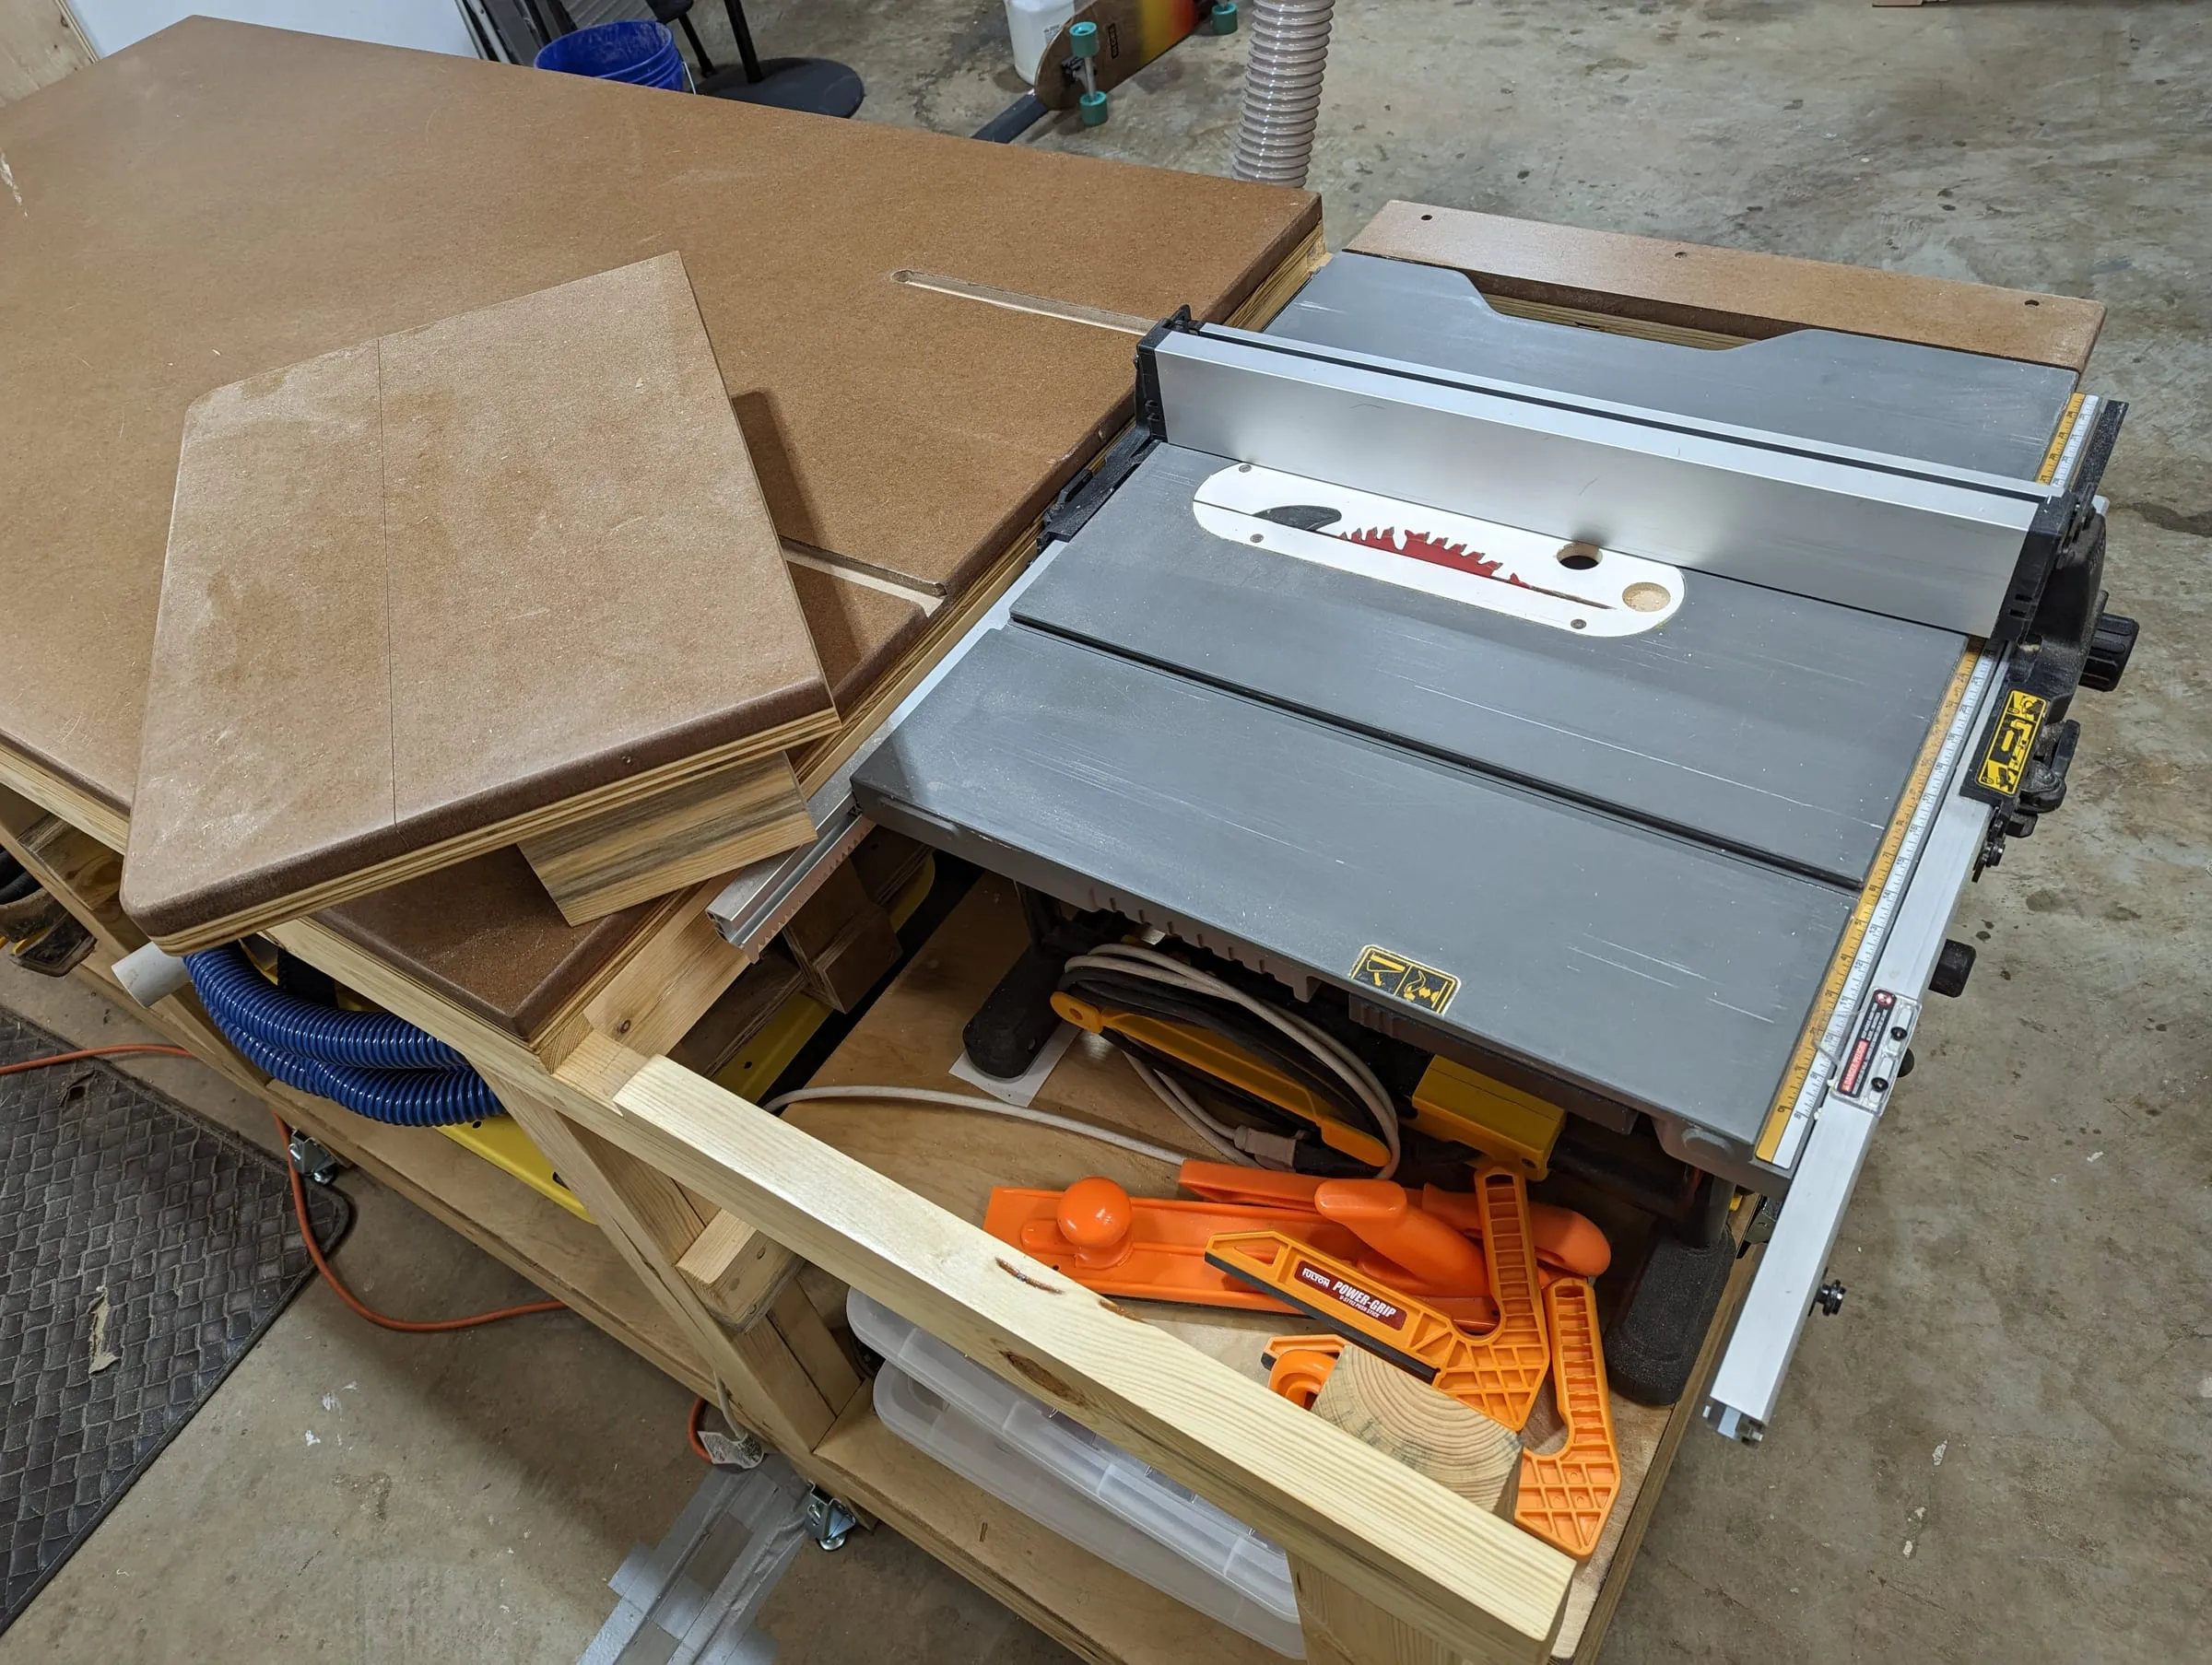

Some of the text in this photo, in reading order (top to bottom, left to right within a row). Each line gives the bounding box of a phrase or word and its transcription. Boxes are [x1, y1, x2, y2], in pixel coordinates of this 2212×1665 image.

[1825, 1033, 1834, 1042] 10
[1840, 995, 1849, 1005] 11
[1854, 959, 1864, 969] 12
[1869, 923, 1877, 933] 13
[1883, 890, 1891, 899] 14
[1897, 856, 1905, 865] 15
[1910, 824, 1918, 833] 16
[1923, 793, 1931, 803] 17
[1935, 762, 1943, 771] 18
[1959, 705, 1968, 713] 20
[1841, 953, 1848, 961] 4
[1302, 1267, 1330, 1287] FULTON
[1333, 1281, 1396, 1317] POWER-GRIP
[1355, 1303, 1368, 1312] PUSH
[1366, 1307, 1380, 1319] STICK
